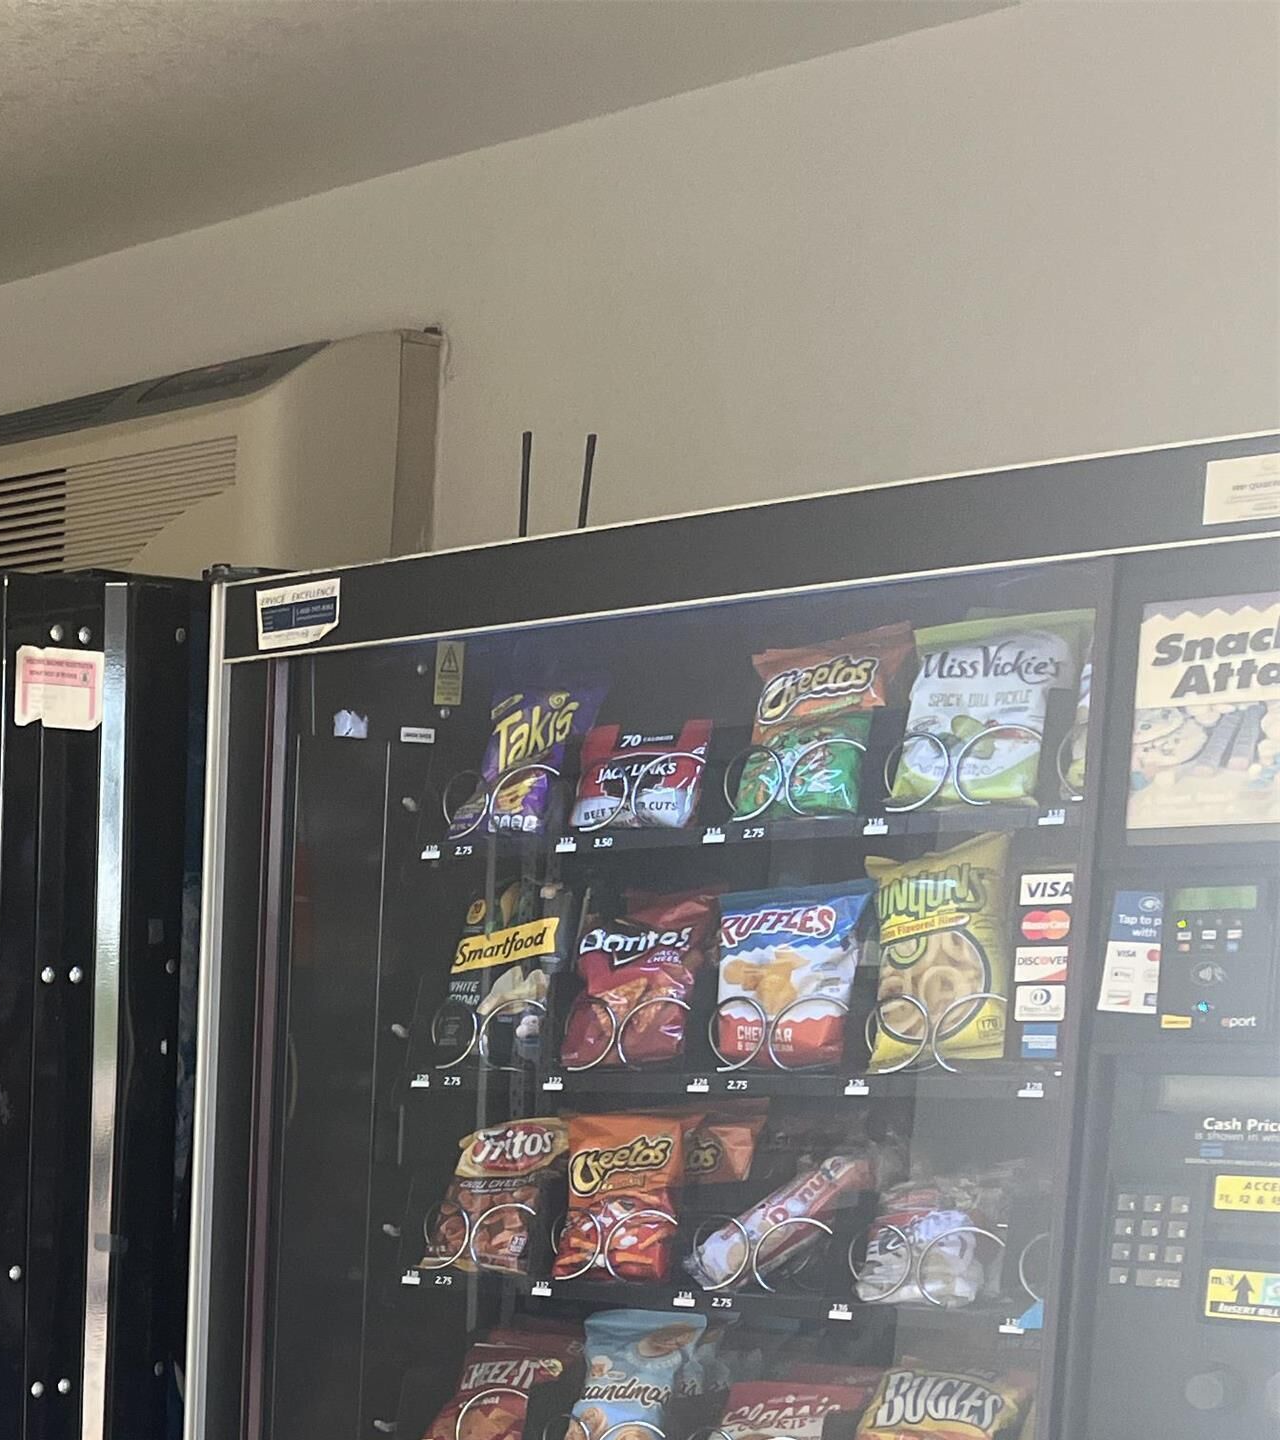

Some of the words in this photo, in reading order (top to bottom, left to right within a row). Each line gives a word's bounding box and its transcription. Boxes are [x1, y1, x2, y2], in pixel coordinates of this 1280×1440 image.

[1152, 619, 1280, 667] Snac
[980, 641, 1061, 685] Vickie's
[758, 655, 878, 725] Cheetos
[492, 691, 579, 774] Takis
[620, 734, 641, 748] 70
[583, 804, 607, 821] BEEF
[648, 800, 678, 813] CUTS
[743, 827, 765, 838] 2.75
[455, 846, 473, 856] 2.75
[593, 837, 613, 848] 3.50
[1027, 881, 1072, 898] VISA
[721, 905, 837, 948] RUFFLES
[1118, 914, 1138, 926] Tap
[456, 927, 546, 967] Smartfood
[580, 926, 694, 955] Doritos
[444, 1077, 461, 1086] 2.75
[727, 1080, 748, 1090] 2.75
[1204, 1117, 1242, 1131] Cash
[473, 1125, 554, 1163] Fritos
[569, 1135, 674, 1197] Cheetos
[435, 1276, 452, 1286] 2.75
[712, 1298, 733, 1308] 2.75
[876, 1370, 1002, 1429] BUGLES
